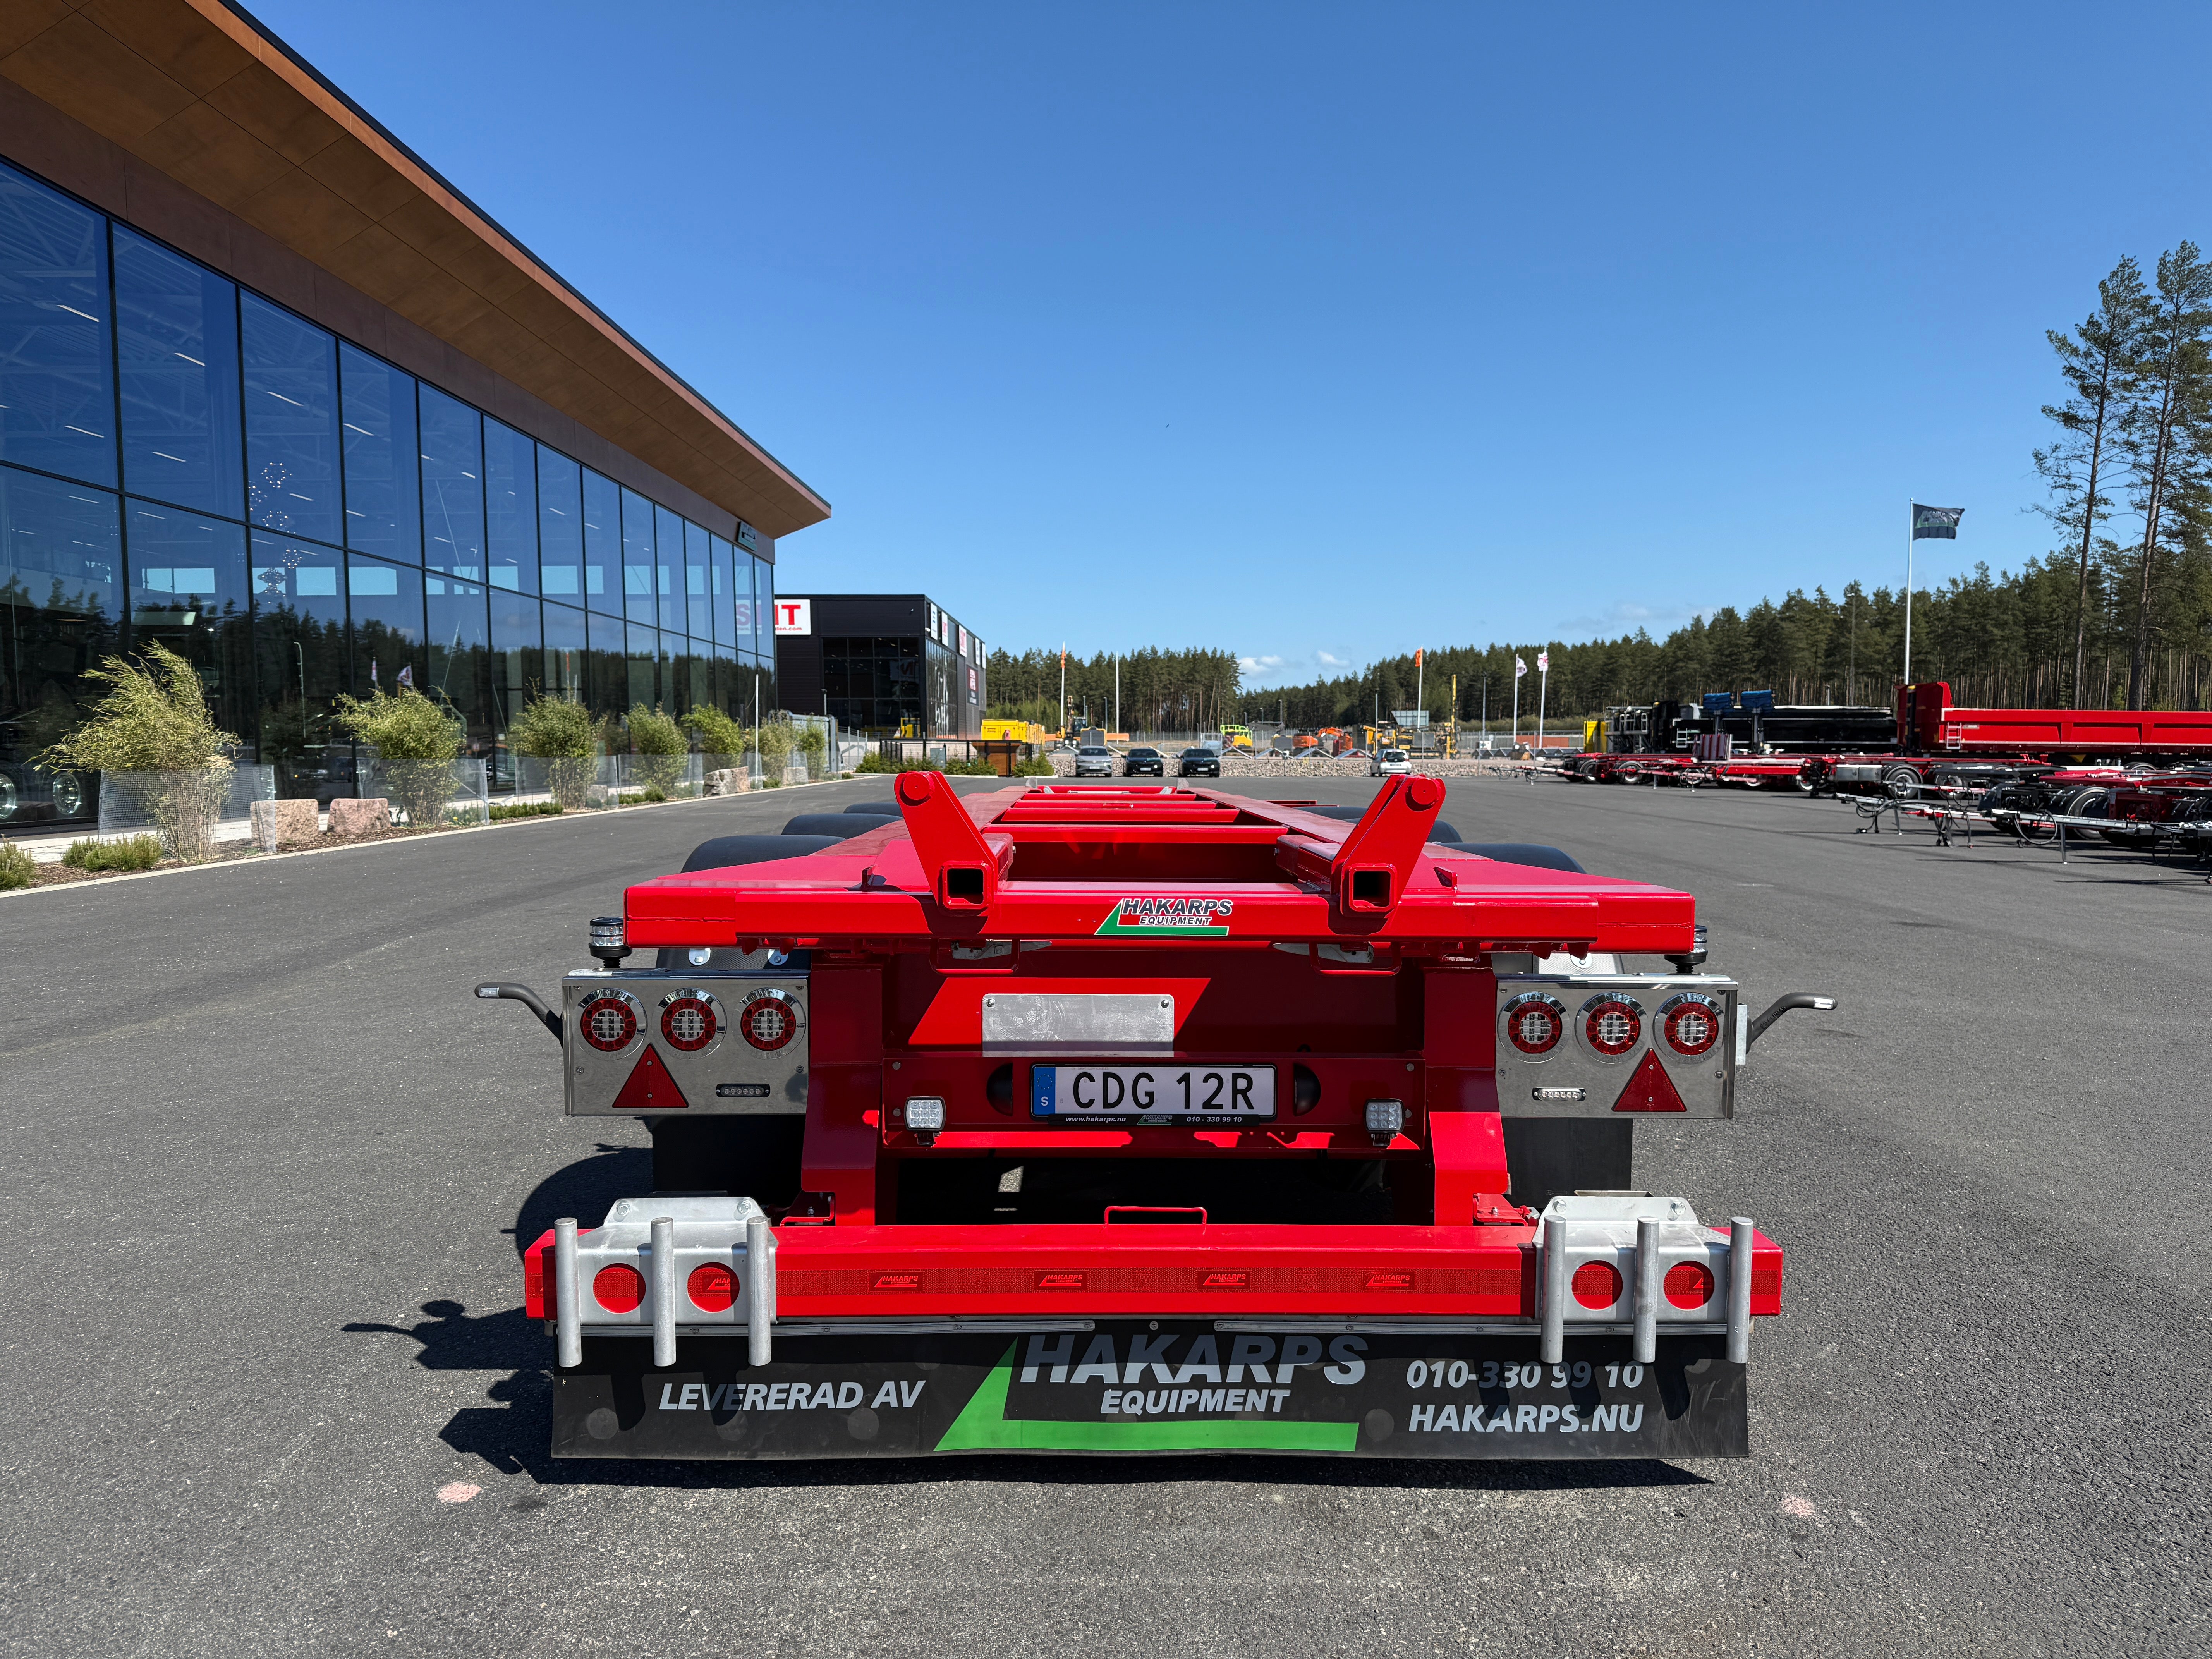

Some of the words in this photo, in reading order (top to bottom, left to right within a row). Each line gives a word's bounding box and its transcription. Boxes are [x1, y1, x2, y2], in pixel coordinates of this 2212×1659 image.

[1122, 898, 1233, 915] HAKARPS
[1139, 915, 1212, 926] EQUIPMENT
[1041, 1096, 1049, 1106] S
[1073, 1072, 1155, 1109] CDG
[1176, 1072, 1255, 1110] 12R
[1020, 1334, 1369, 1385] HAKARPS
[1407, 1360, 1541, 1388] 010-330
[1551, 1361, 1592, 1388] 99
[1604, 1361, 1644, 1388] 10
[659, 1382, 864, 1410] LEVERERAD
[871, 1380, 926, 1408] AV
[1100, 1389, 1290, 1415] EQUIPMENT
[1408, 1404, 1644, 1432] HAKARPS.NU
